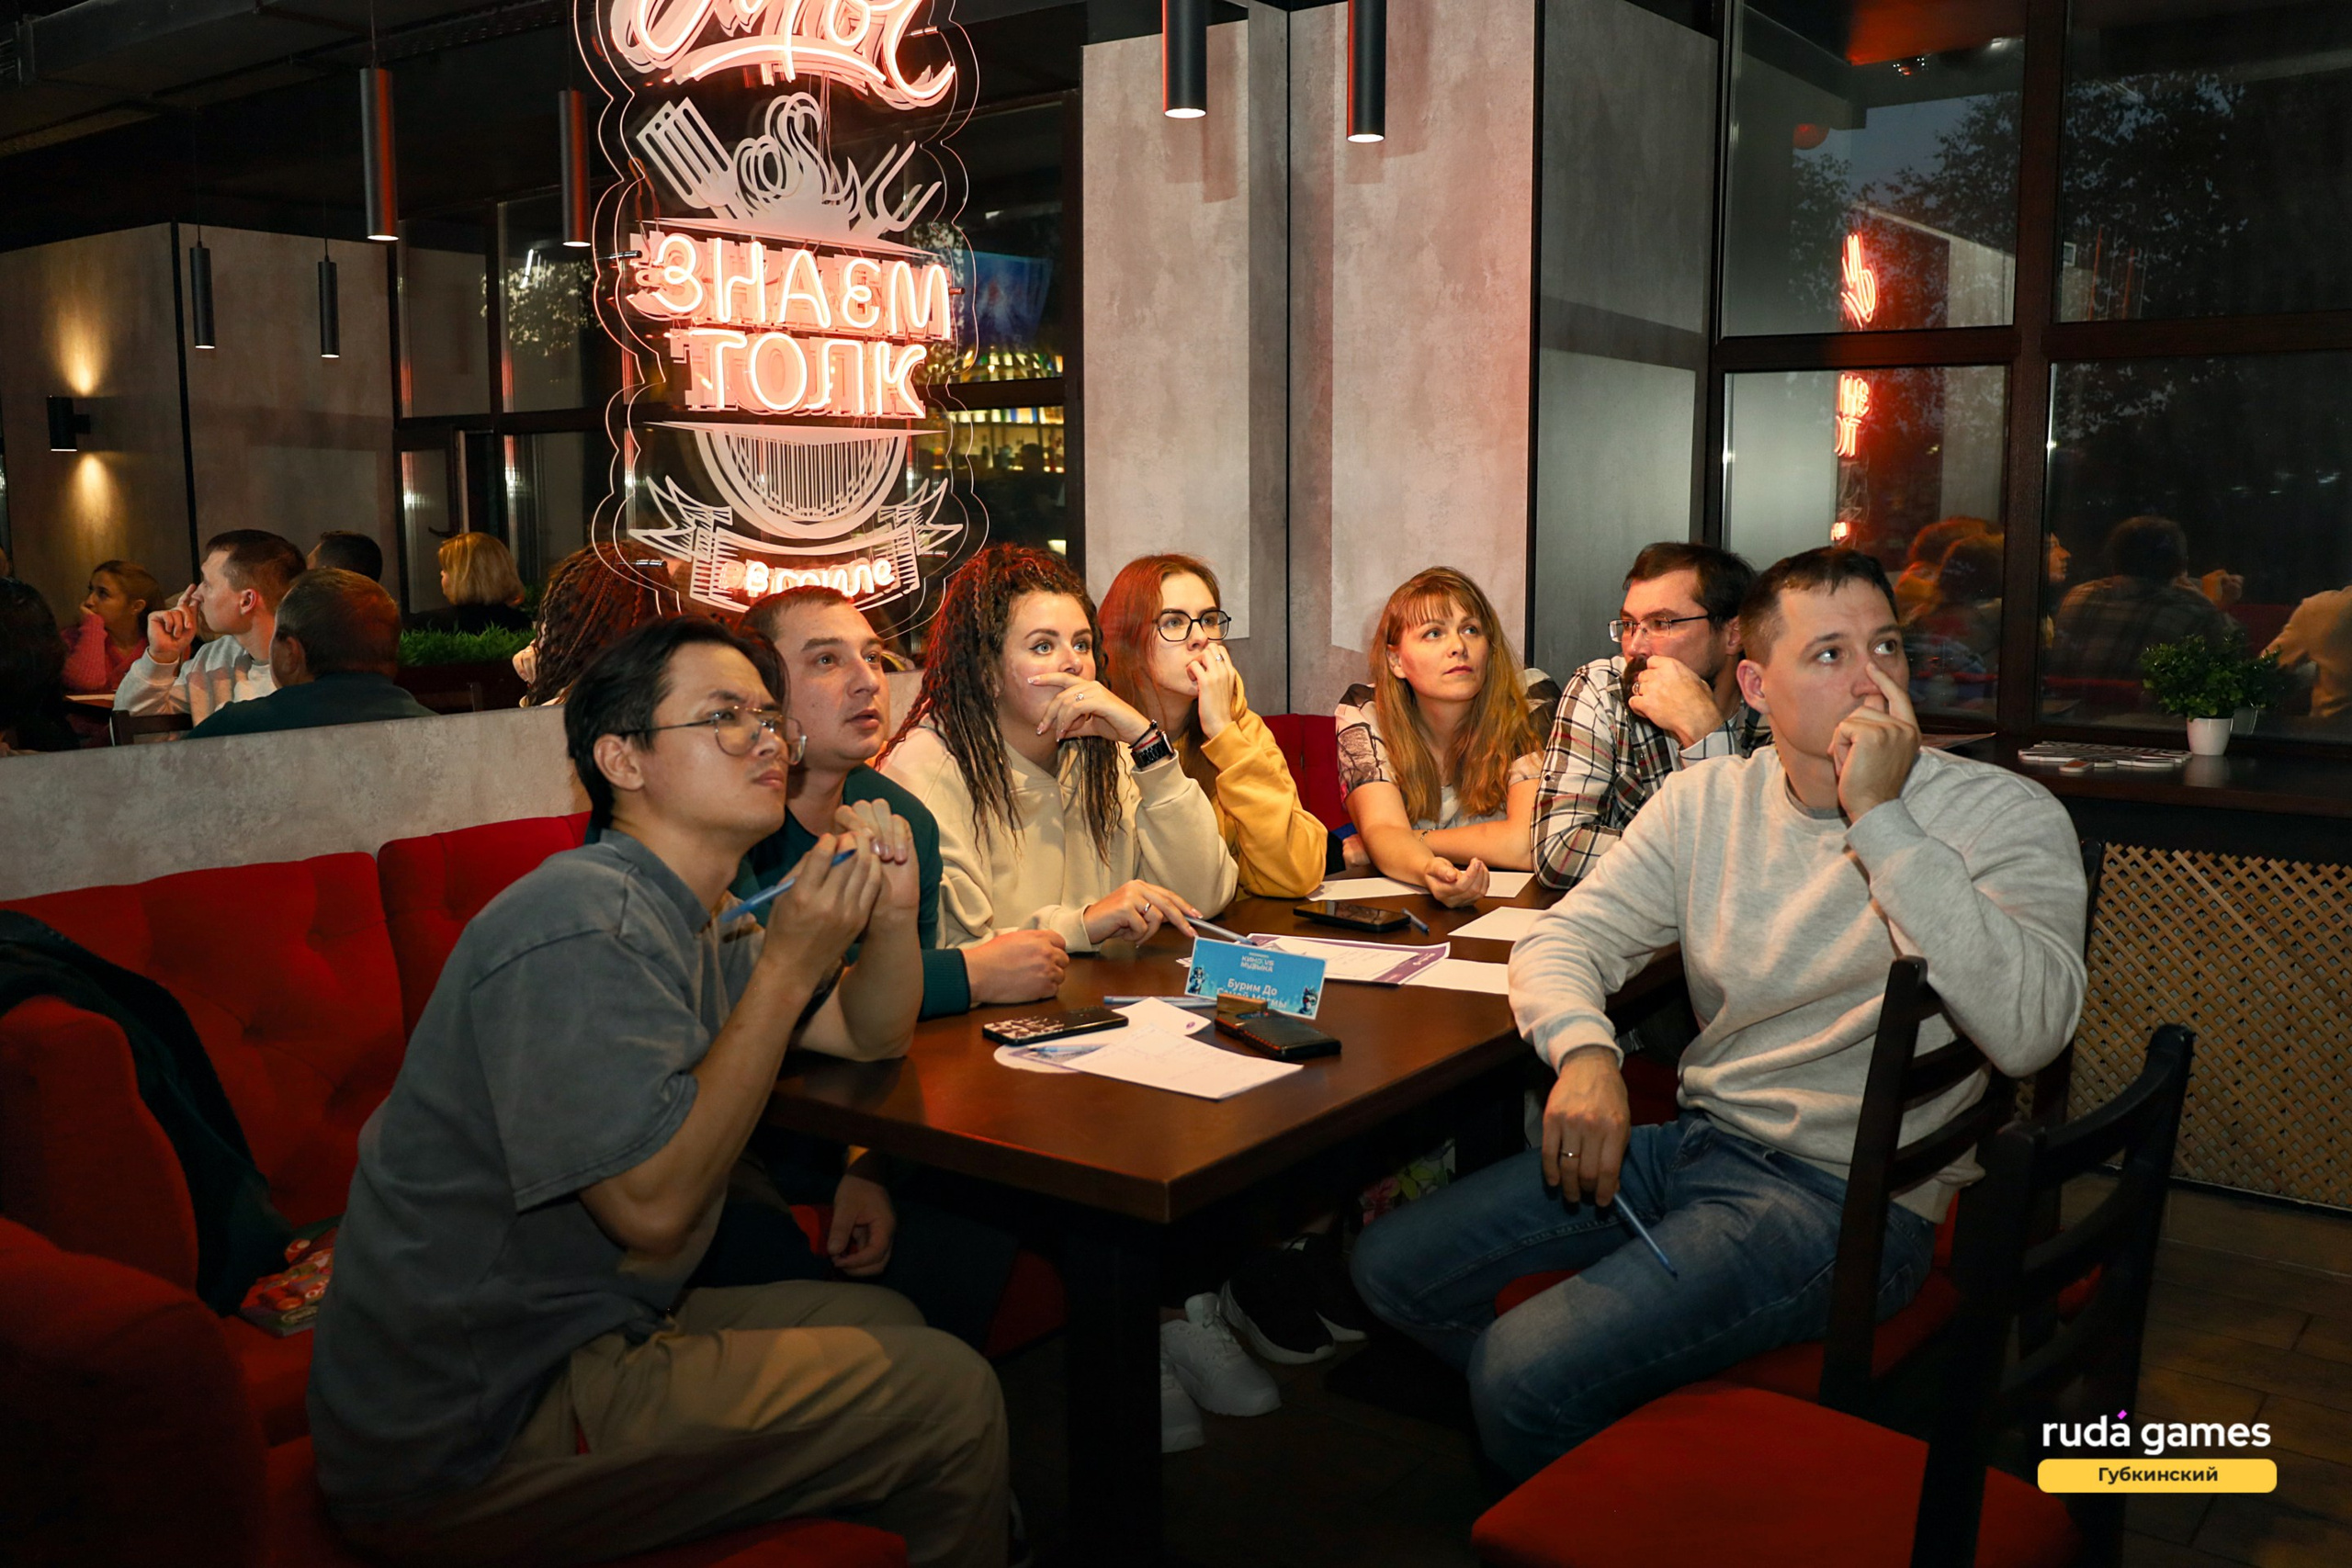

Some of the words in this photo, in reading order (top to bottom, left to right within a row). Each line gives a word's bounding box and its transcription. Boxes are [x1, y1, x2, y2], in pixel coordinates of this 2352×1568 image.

[645, 232, 952, 340] ЗНАЕМ
[674, 328, 926, 419] ТОЛК
[1227, 977, 1261, 992] Бурим
[1261, 984, 1278, 996] До
